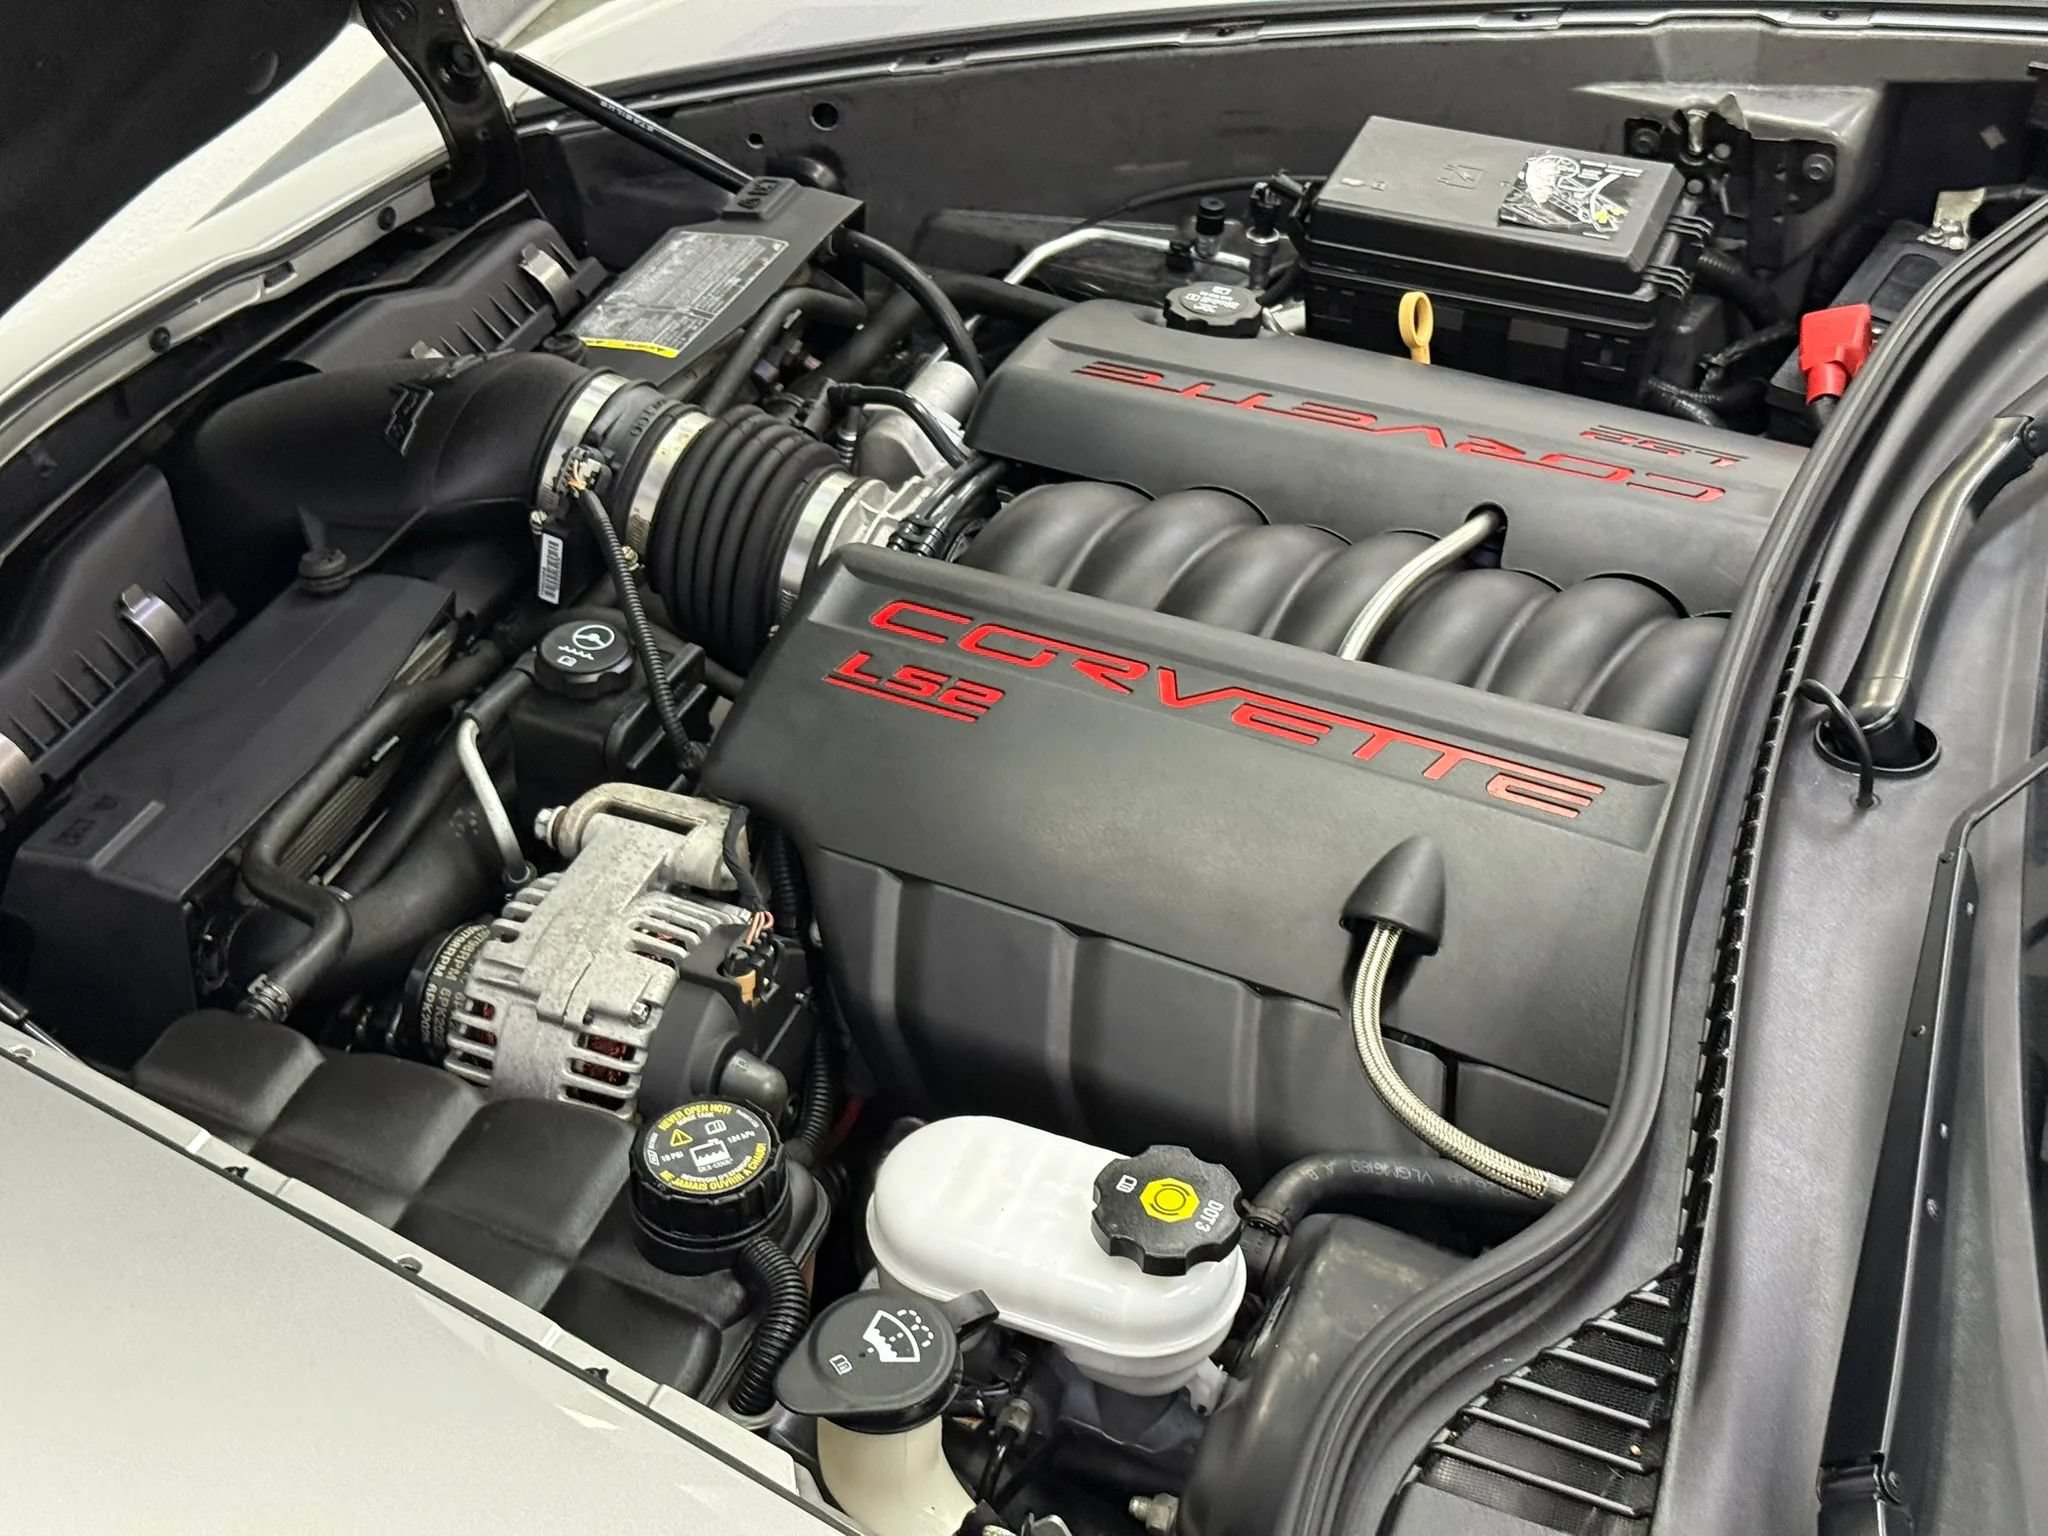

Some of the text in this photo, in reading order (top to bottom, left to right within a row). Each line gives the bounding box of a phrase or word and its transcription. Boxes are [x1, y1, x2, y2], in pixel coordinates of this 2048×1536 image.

[1071, 361, 1726, 501] CORVETTE
[1579, 427, 1744, 467] LS2
[830, 651, 1006, 720] LS2
[868, 600, 1606, 819] CORVETTE
[658, 1108, 685, 1132] NEVER
[685, 1104, 709, 1116] OPEN
[660, 1169, 676, 1182] NE
[671, 1177, 709, 1191] JAMAIS
[709, 1172, 744, 1190] OUVRIR
[1194, 1199, 1225, 1233] DOT 3
